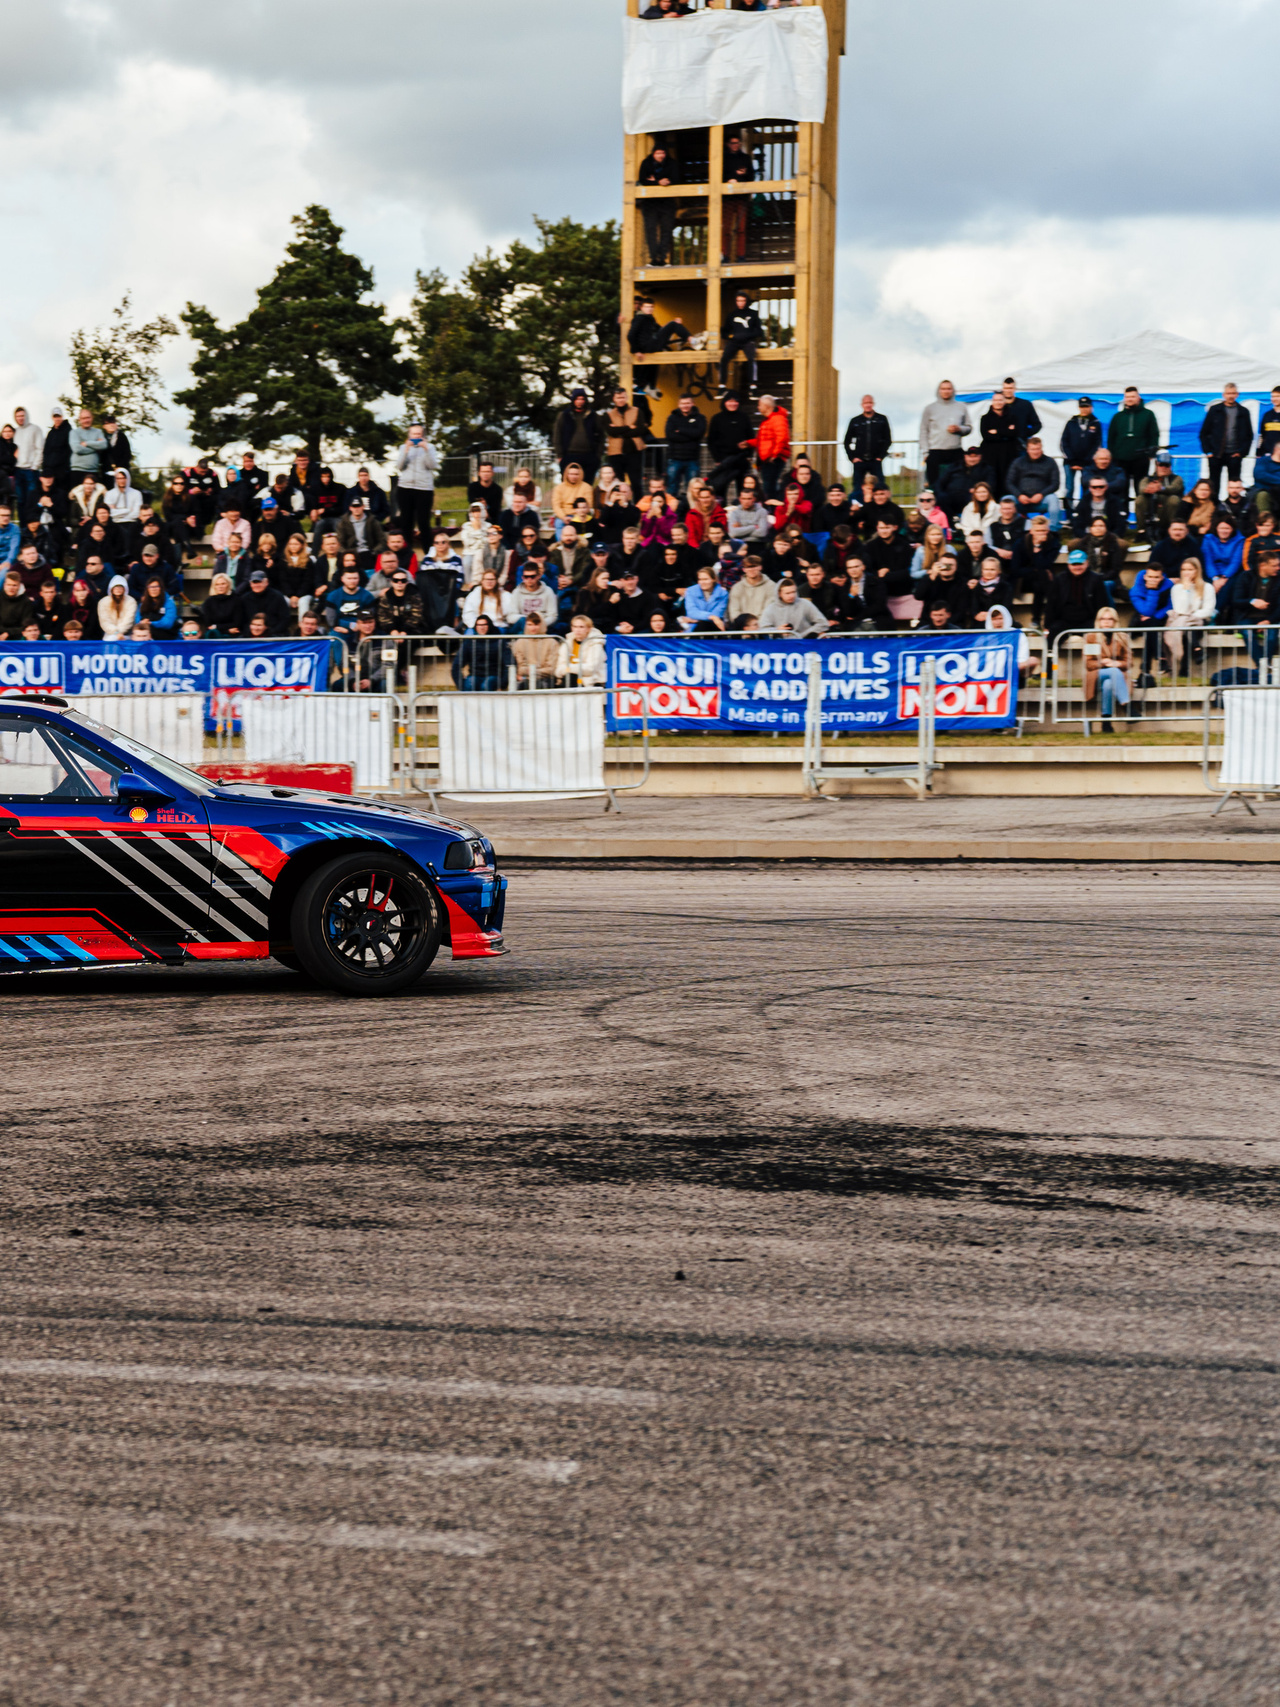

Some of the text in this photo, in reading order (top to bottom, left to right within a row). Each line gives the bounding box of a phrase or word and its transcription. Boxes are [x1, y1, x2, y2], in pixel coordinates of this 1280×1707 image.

[72, 654, 205, 675] MOTOR OILS
[217, 656, 312, 686] LIQUI
[619, 652, 715, 685] LIQUI
[828, 651, 891, 674] OILS
[80, 677, 196, 694] ADDITIVES
[729, 678, 891, 701] & ADDTIVES
[620, 685, 718, 715] MOLY
[728, 708, 778, 723] Made
[782, 709, 800, 723] in
[156, 813, 198, 823] HELIX
